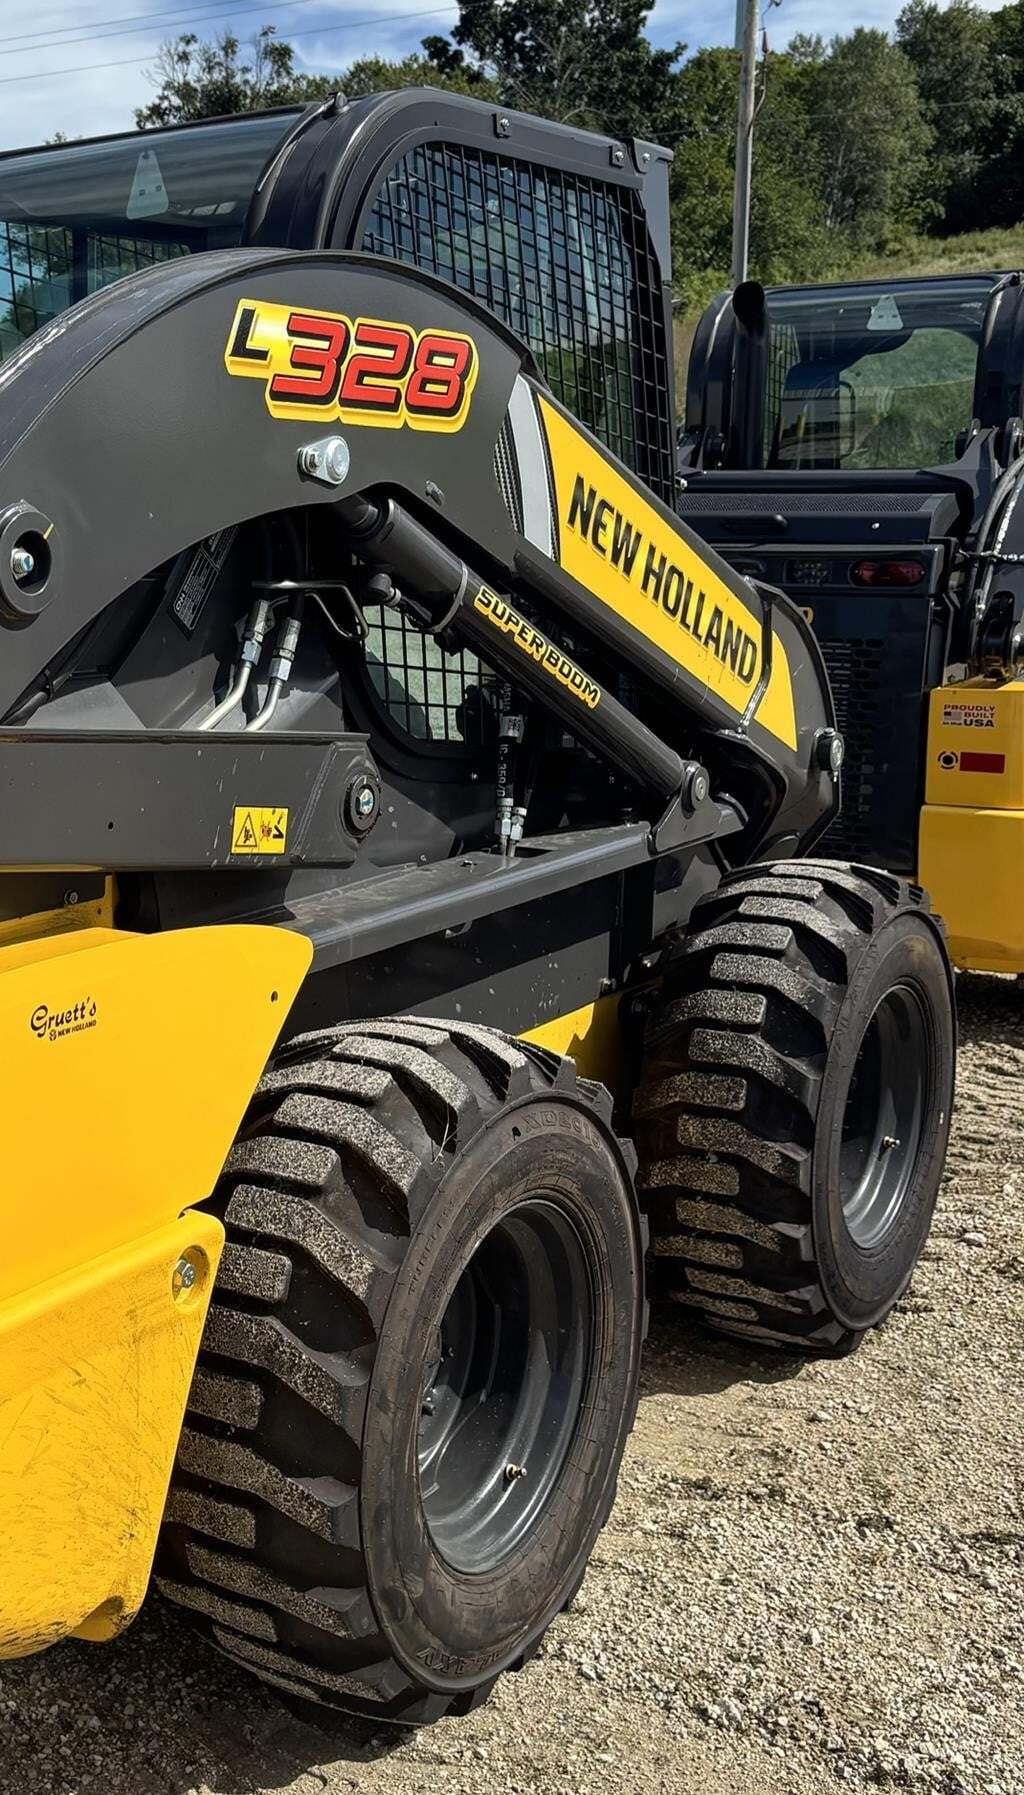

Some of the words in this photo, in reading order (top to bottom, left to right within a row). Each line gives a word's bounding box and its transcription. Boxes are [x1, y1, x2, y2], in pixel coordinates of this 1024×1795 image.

[566, 472, 643, 578] NEW
[640, 541, 758, 685] HOLLAND
[943, 703, 996, 712] PROUDLY
[963, 711, 995, 719] BUILT
[963, 718, 995, 728] USA
[30, 995, 97, 1038] Gruett's
[58, 1026, 71, 1038] NEW
[71, 1019, 97, 1033] HOLLAND
